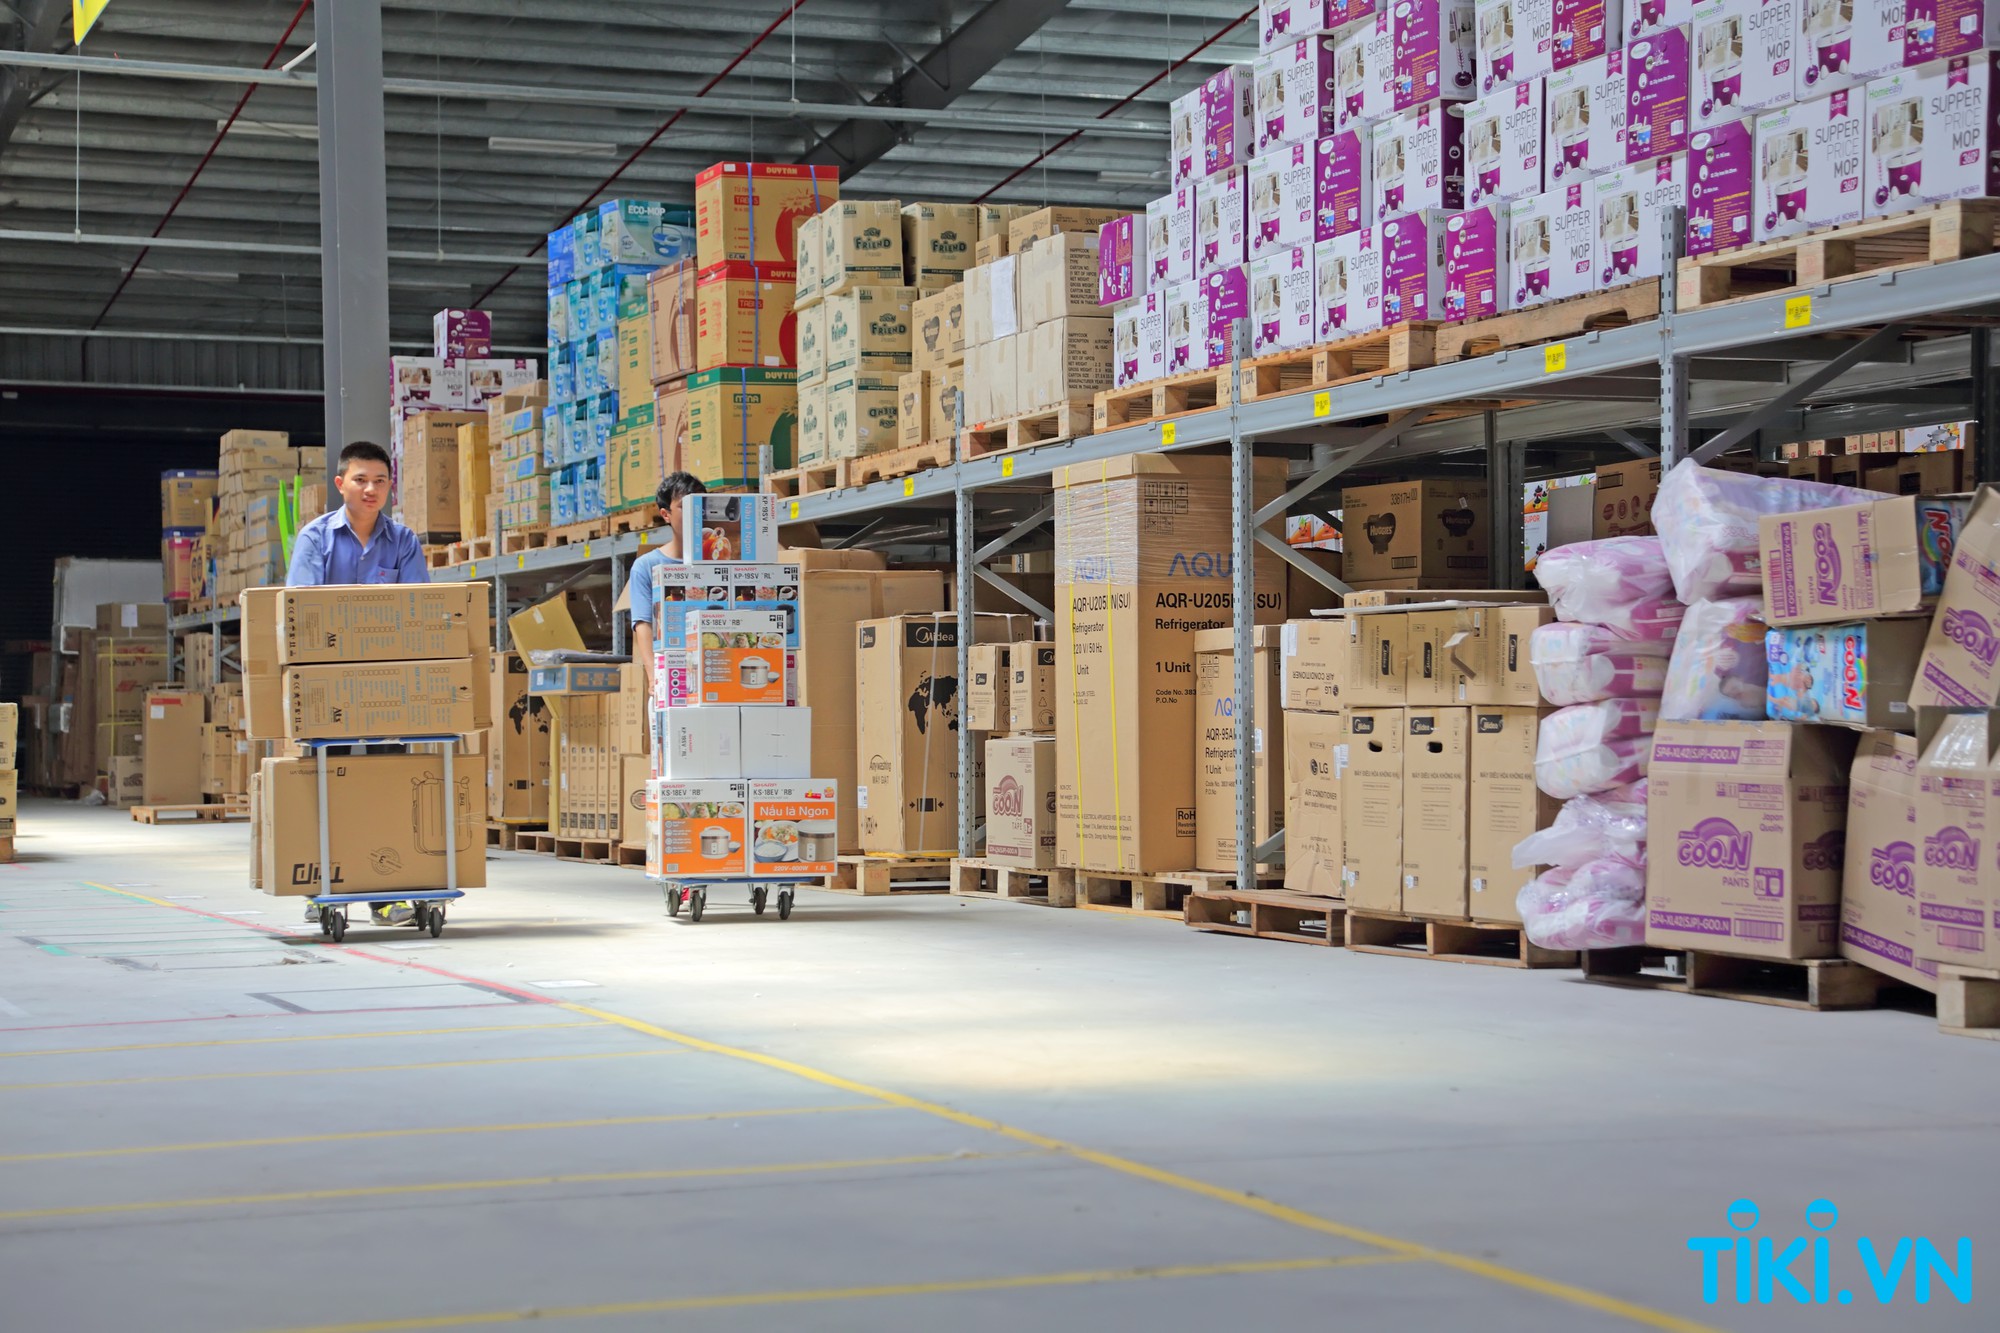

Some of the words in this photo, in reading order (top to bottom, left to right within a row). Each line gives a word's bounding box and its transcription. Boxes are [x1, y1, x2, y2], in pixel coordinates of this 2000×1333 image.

[1527, 7, 1551, 27] PRICE
[1749, 3, 1791, 31] SUPPER
[1533, 22, 1551, 42] MOP
[1760, 21, 1791, 46] PRICE
[1367, 34, 1394, 56] SUPPER
[1767, 40, 1791, 62] MOP
[1287, 61, 1315, 82] SUPPER
[1379, 65, 1394, 82] MOP
[1295, 76, 1315, 94] PRICE
[1300, 91, 1315, 107] MOP
[1931, 87, 1982, 115] SUPPER
[1505, 107, 1537, 131] SUPPER
[1945, 107, 1981, 132] PRICE
[1408, 128, 1438, 150] SUPPER
[1514, 123, 1537, 144] PRICE
[1815, 119, 1859, 145] SUPPER
[1953, 128, 1980, 150] MOP
[1416, 144, 1437, 163] PRICE
[1519, 139, 1537, 158] MOP
[1827, 138, 1859, 161] PRICE
[1284, 167, 1311, 186] SUPPER
[1421, 159, 1438, 177] MOP
[1834, 157, 1859, 178] MOP
[1291, 181, 1311, 199] PRICE
[1644, 184, 1682, 208] SUPPER
[1221, 192, 1241, 210] SUPPER
[1295, 196, 1311, 211] MOP
[628, 205, 666, 216] ECO-MOP
[1171, 209, 1191, 229] SUPPER
[1555, 209, 1591, 232] SUPPER
[1179, 235, 1190, 251] MOP
[1564, 226, 1590, 246] PRICE
[1351, 251, 1379, 271] SUPPER
[1571, 243, 1590, 261] MOP
[1284, 270, 1310, 289] SUPPER
[1358, 266, 1379, 284] PRICE
[1363, 281, 1379, 297] MOP
[1295, 300, 1310, 315] MOP
[1140, 314, 1162, 331] SUPPER
[1150, 338, 1162, 354] MOP
[1316, 360, 1325, 373] PT
[744, 531, 753, 555] Ngon
[1167, 552, 1256, 578] AQU
[663, 572, 690, 580] KP-19SV
[733, 572, 760, 580] KP-19SV
[1155, 592, 1282, 610] AQR-U205(SU)
[1072, 622, 1105, 636] Refrigerator
[1155, 618, 1226, 632] Refrigerator
[915, 626, 954, 644] Midea
[1155, 662, 1161, 673] 1
[1164, 661, 1191, 673] Unit
[1214, 697, 1235, 717] AQ
[1205, 728, 1236, 741] AQR-95A
[1205, 747, 1236, 761] Refrigerat
[1210, 764, 1222, 775] Unit
[1319, 762, 1329, 774] LG
[753, 788, 779, 796] KS-18EV
[798, 805, 829, 819] Ngon
[1177, 811, 1196, 820] RoH
[1762, 813, 1784, 822] Japan
[1759, 823, 1784, 834] Quality
[1722, 876, 1750, 889] PANTS
[1755, 878, 1766, 891] XL
